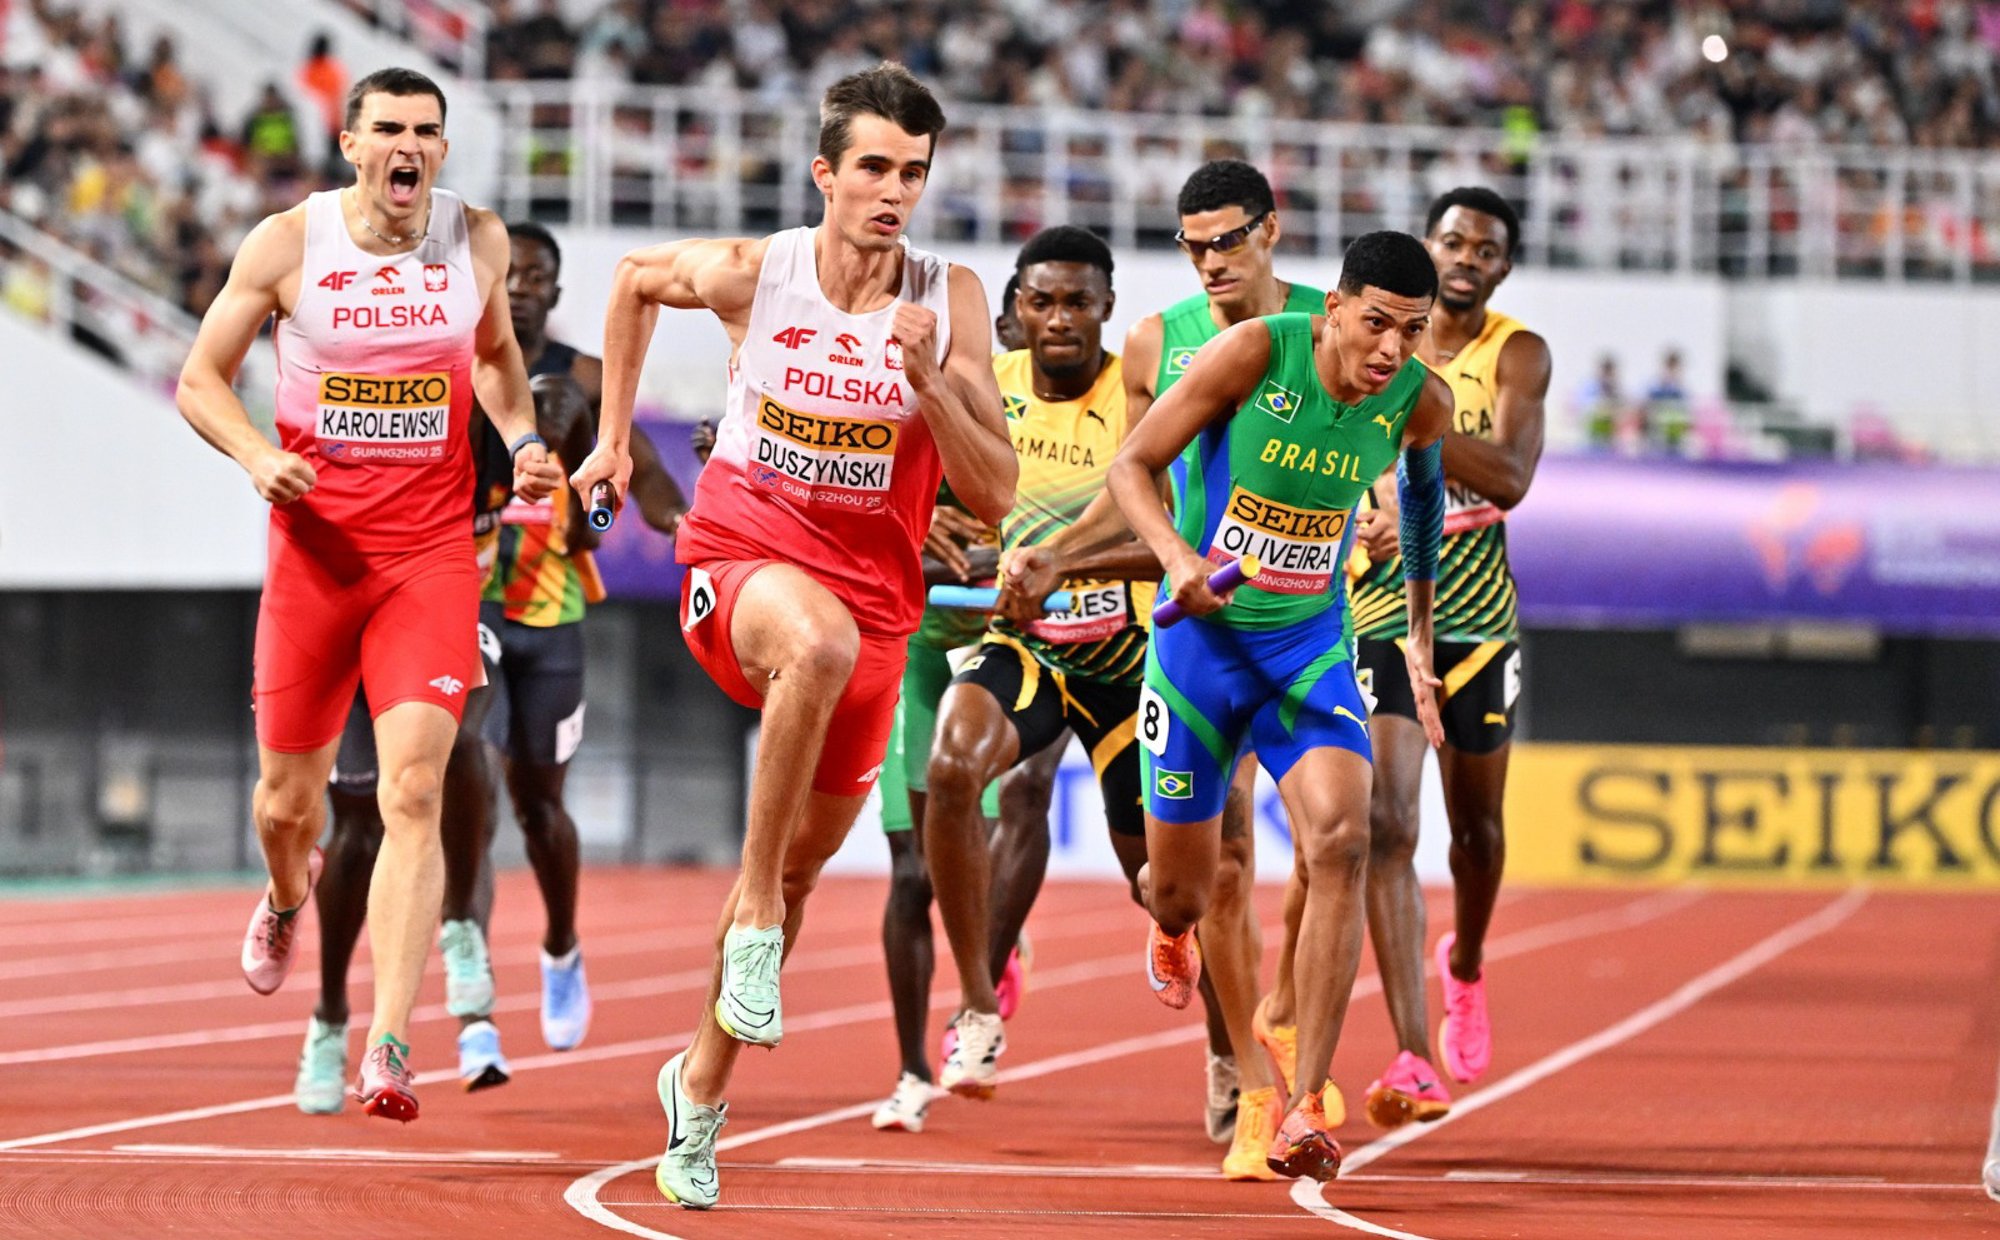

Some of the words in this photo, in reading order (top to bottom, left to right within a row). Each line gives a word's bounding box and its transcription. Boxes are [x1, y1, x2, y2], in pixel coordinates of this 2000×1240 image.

[318, 271, 358, 291] 4F
[371, 286, 405, 296] ORLEN
[333, 304, 448, 329] POLSKA
[773, 327, 818, 350] 4F
[828, 353, 863, 367] ORLEN
[325, 376, 446, 404] SEIKO
[784, 367, 904, 406] POLSKA
[322, 409, 444, 438] KAROLEWSKI
[762, 401, 892, 450] SEIKO
[351, 446, 428, 459] GUANGZHOU
[429, 445, 443, 458] 25
[758, 437, 886, 488] DUSZYŃSKI
[1014, 436, 1095, 468] AMAICA
[1260, 438, 1360, 482] BRASIL
[782, 481, 863, 506] GUANGZHOU
[865, 496, 881, 508] 25
[1232, 494, 1345, 538] SEIKO
[1223, 526, 1332, 570] OLIVEIRA
[428, 674, 465, 696] 4F
[1144, 699, 1160, 741] 8
[1574, 766, 2000, 872] SEIK
